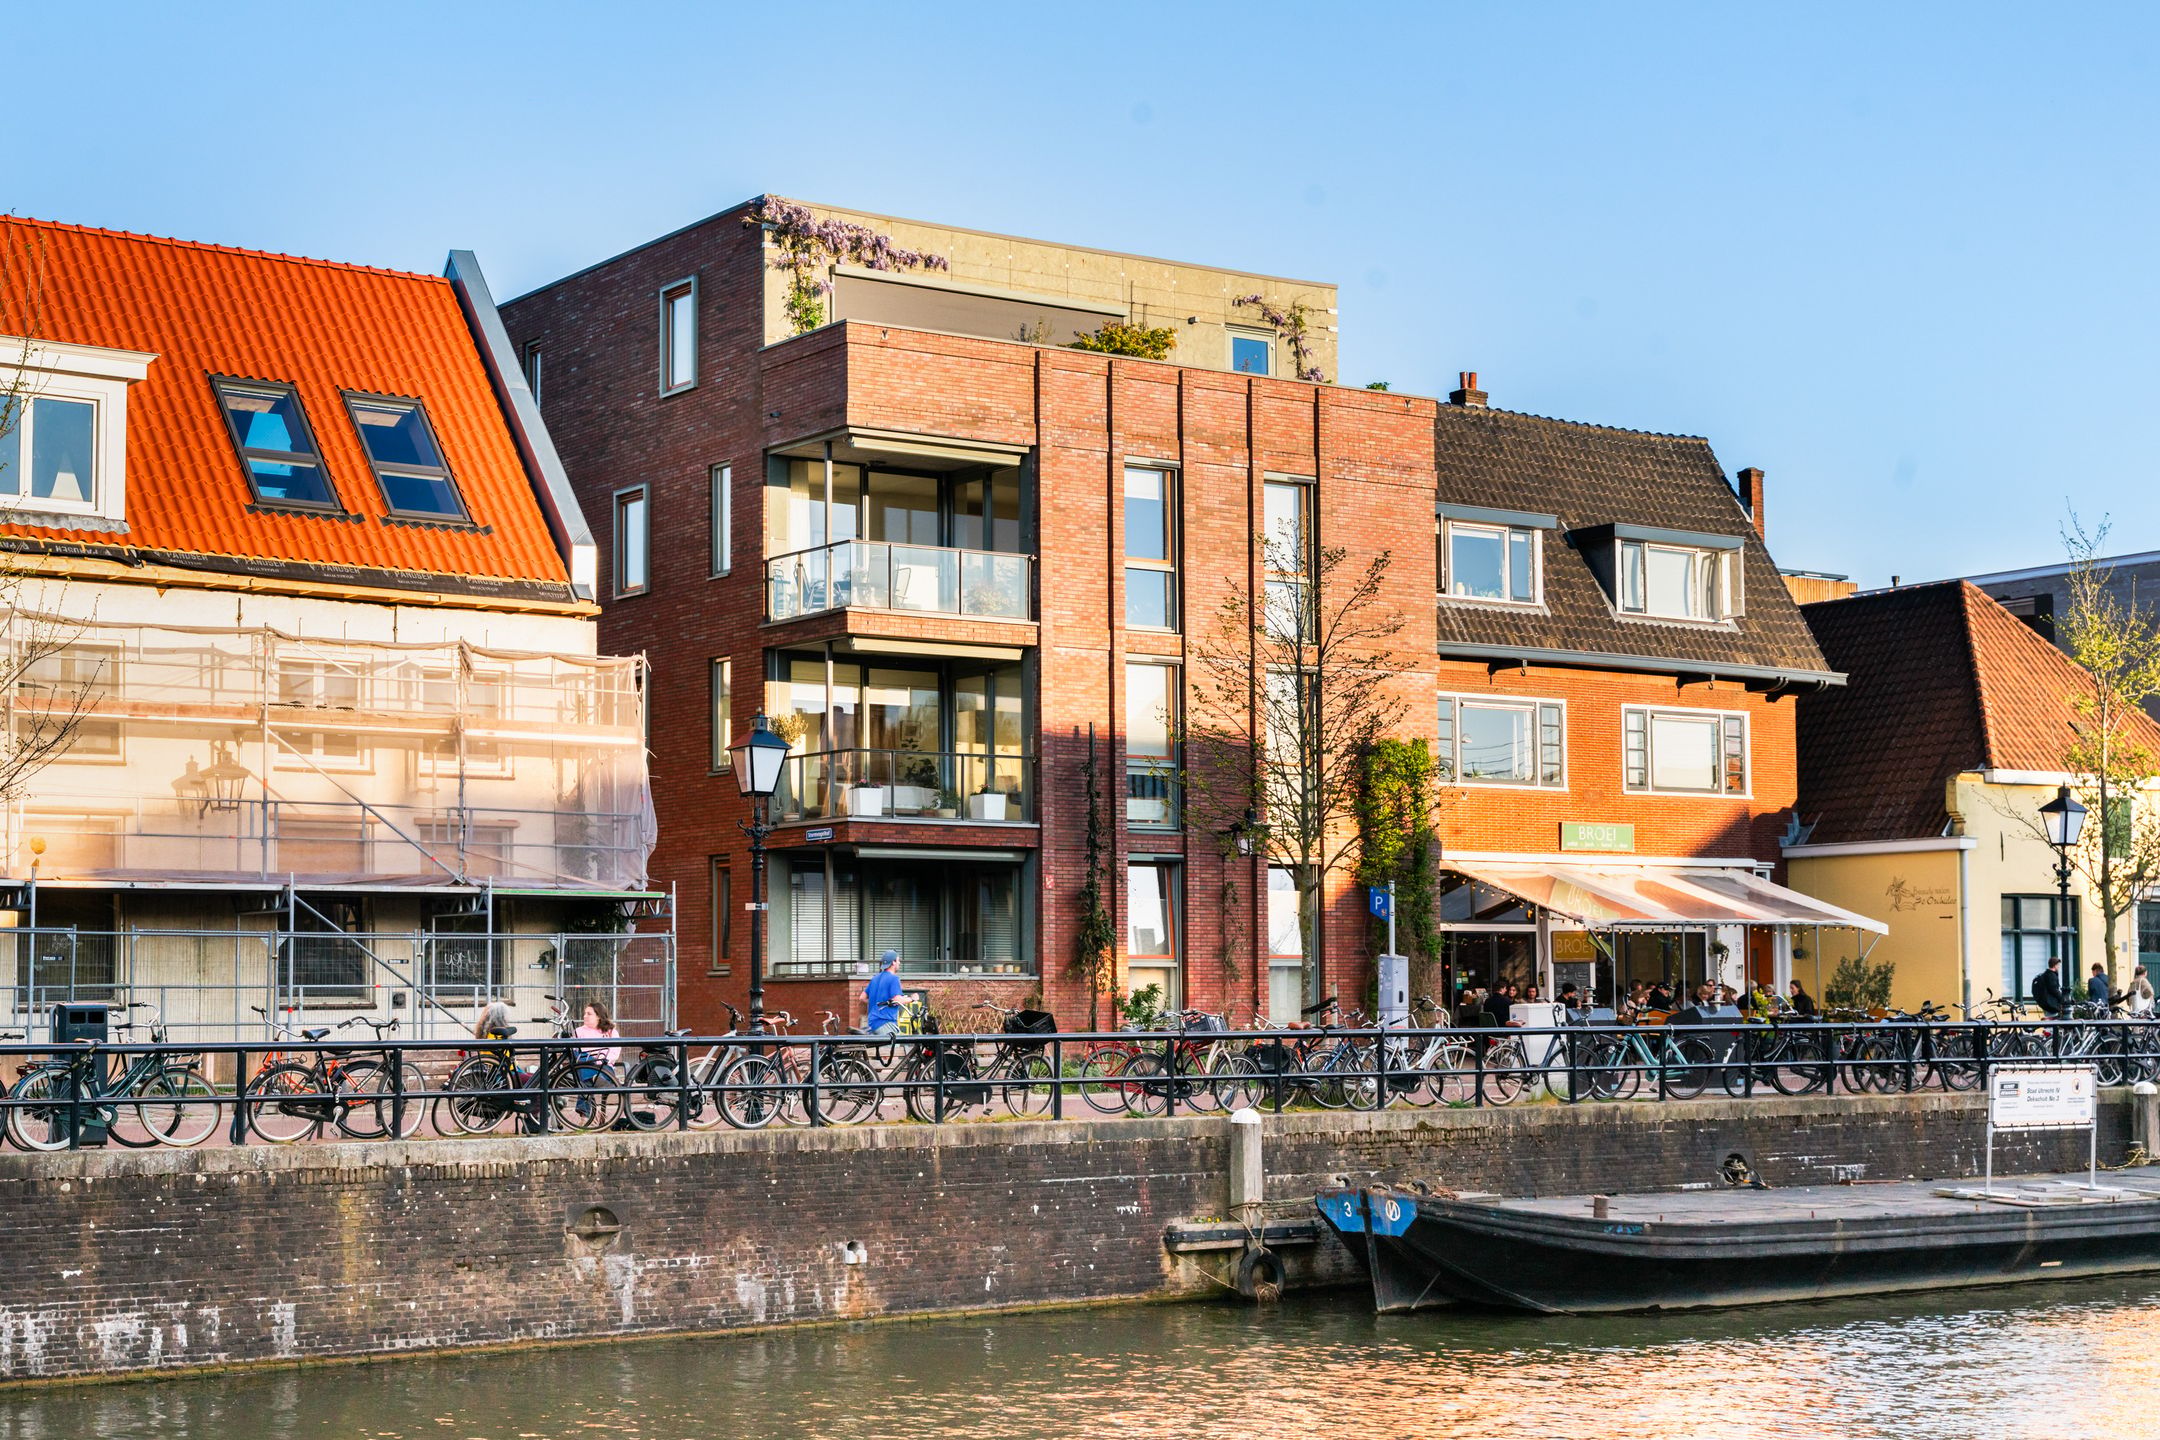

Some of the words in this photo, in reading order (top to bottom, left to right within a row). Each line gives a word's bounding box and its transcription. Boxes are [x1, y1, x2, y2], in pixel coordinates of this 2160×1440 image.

[1578, 826, 1616, 841] BROEI
[1375, 896, 1383, 910] P
[1343, 1201, 1352, 1217] 3
